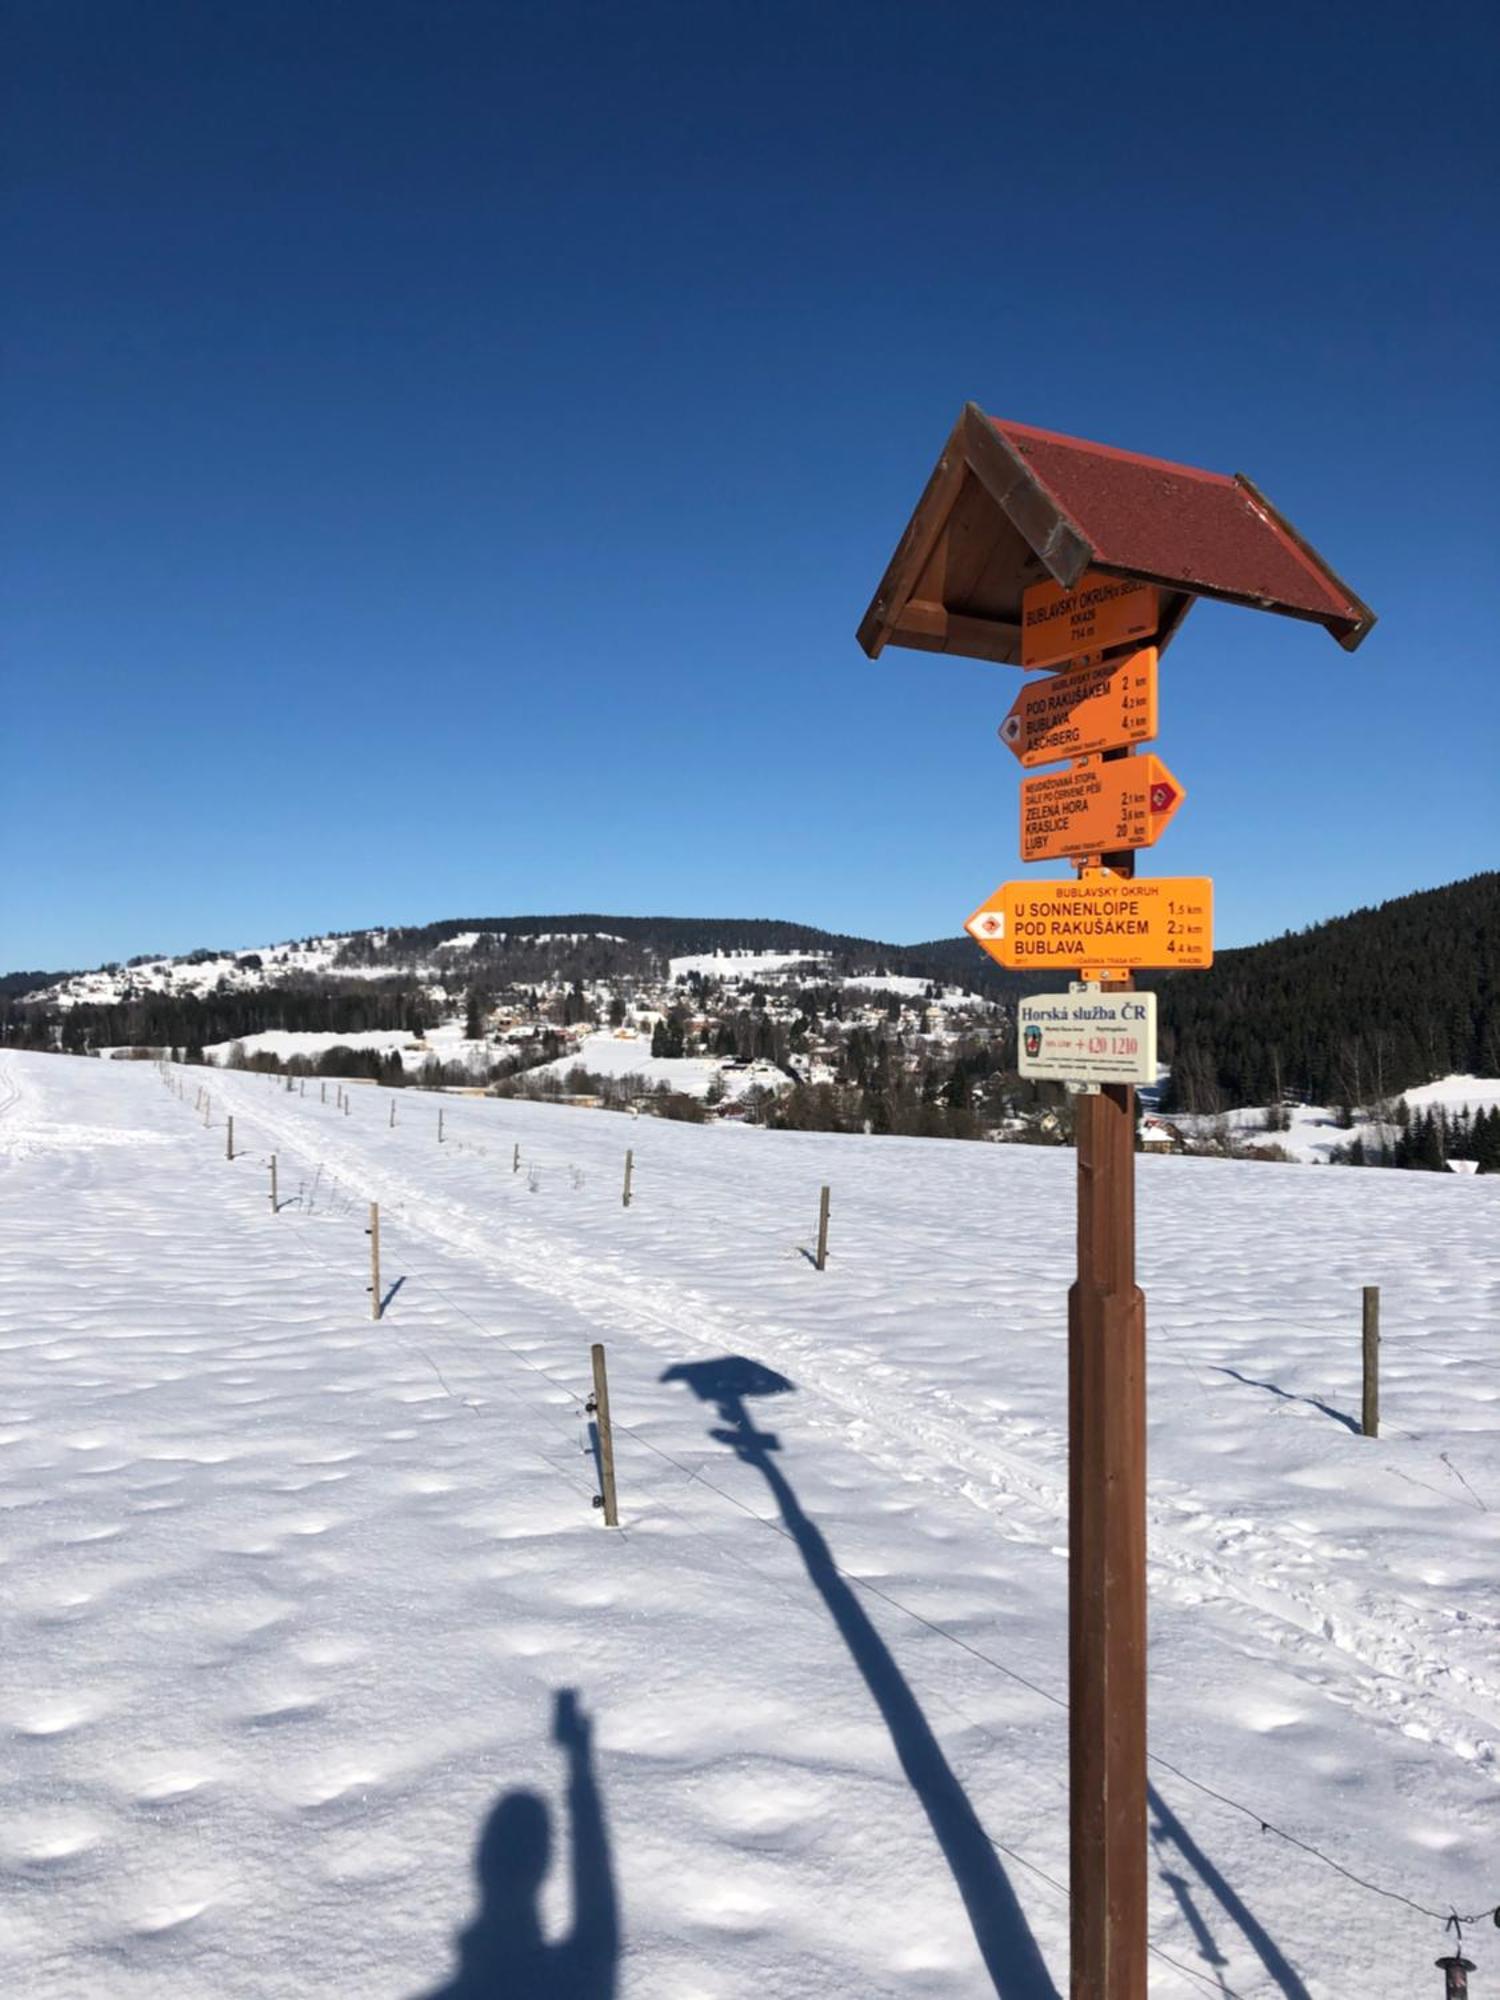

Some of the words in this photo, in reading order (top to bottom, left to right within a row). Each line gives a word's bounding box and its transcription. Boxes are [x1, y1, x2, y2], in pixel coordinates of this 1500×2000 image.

[1026, 700, 1046, 716] POD
[1122, 676, 1129, 690] 2
[1136, 678, 1146, 686] km
[1026, 712, 1070, 734] BUBLAVA
[1136, 697, 1147, 706] km
[1026, 727, 1080, 750] ASCHBERG
[1136, 717, 1147, 726] km
[1062, 799, 1088, 815] HORA
[1135, 794, 1145, 803] km
[1025, 816, 1069, 834] KRASLICE
[1135, 810, 1145, 819] km
[1025, 836, 1049, 850] LUBY
[1116, 824, 1128, 838] 20
[1135, 826, 1145, 835] km
[1121, 886, 1158, 897] OKRUH
[1015, 903, 1025, 917] U
[1029, 901, 1139, 917] SONNENLOIPE
[1187, 905, 1202, 914] km
[1015, 921, 1046, 936] POD
[1051, 917, 1149, 935] RAKUŠÁKEM
[1187, 924, 1202, 933] km
[1015, 940, 1085, 954] BUBLAVA
[1187, 943, 1202, 953] km
[1022, 1006, 1068, 1020] Horská
[1073, 1006, 1116, 1020] služba
[1121, 1002, 1146, 1020] ČR
[1112, 1037, 1138, 1055] 1210
